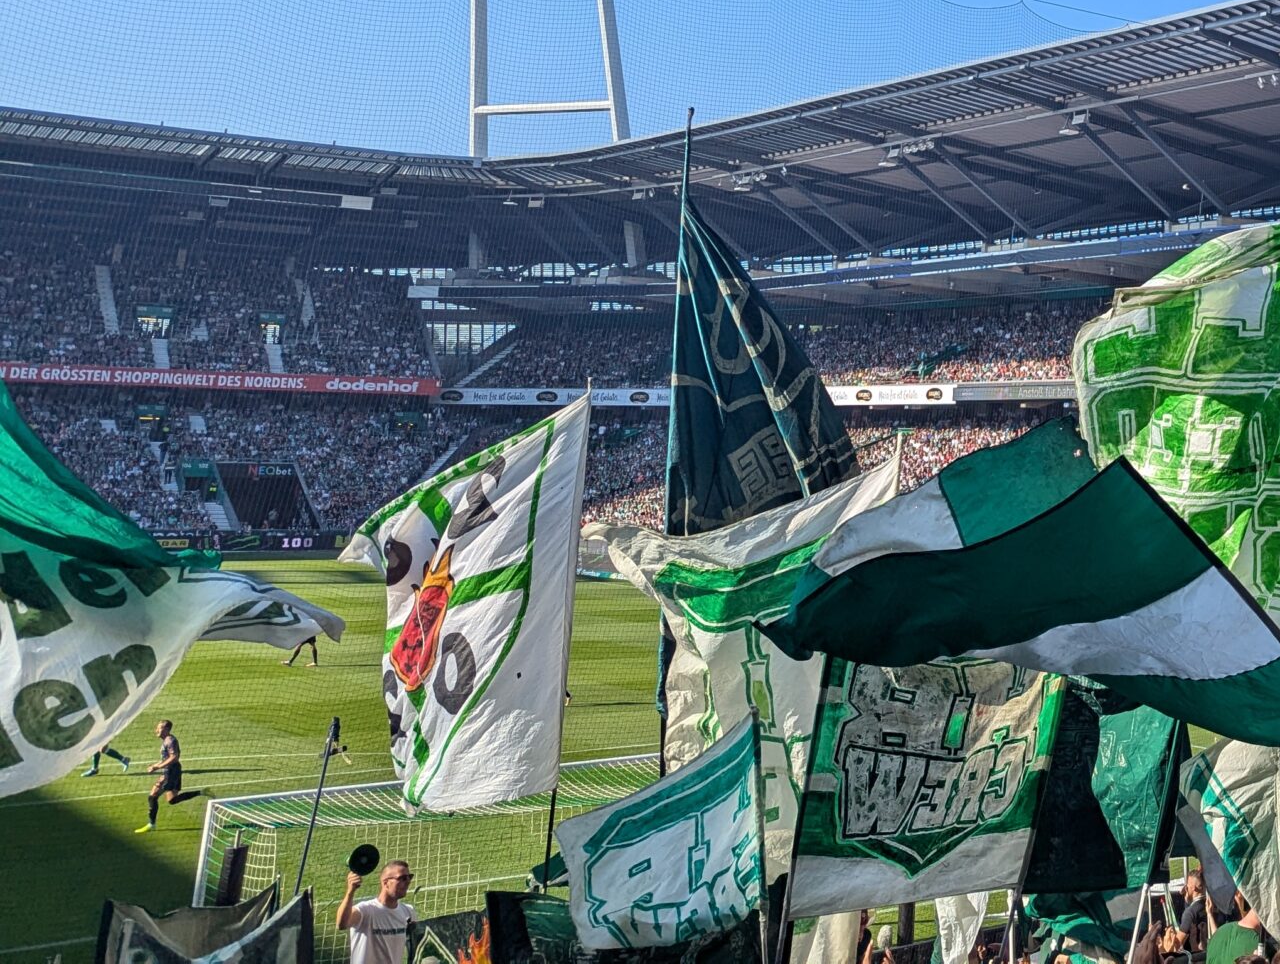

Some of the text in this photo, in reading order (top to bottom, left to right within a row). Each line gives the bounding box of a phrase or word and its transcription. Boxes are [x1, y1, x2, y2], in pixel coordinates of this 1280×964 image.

[9, 367, 38, 380] DER
[41, 365, 112, 382] GRÖSSTEN
[113, 370, 216, 387] SHOPPINGWELT
[218, 374, 242, 387] DES
[325, 378, 420, 393] dodenhof
[473, 391, 488, 402] Mein
[282, 537, 313, 548] 100
